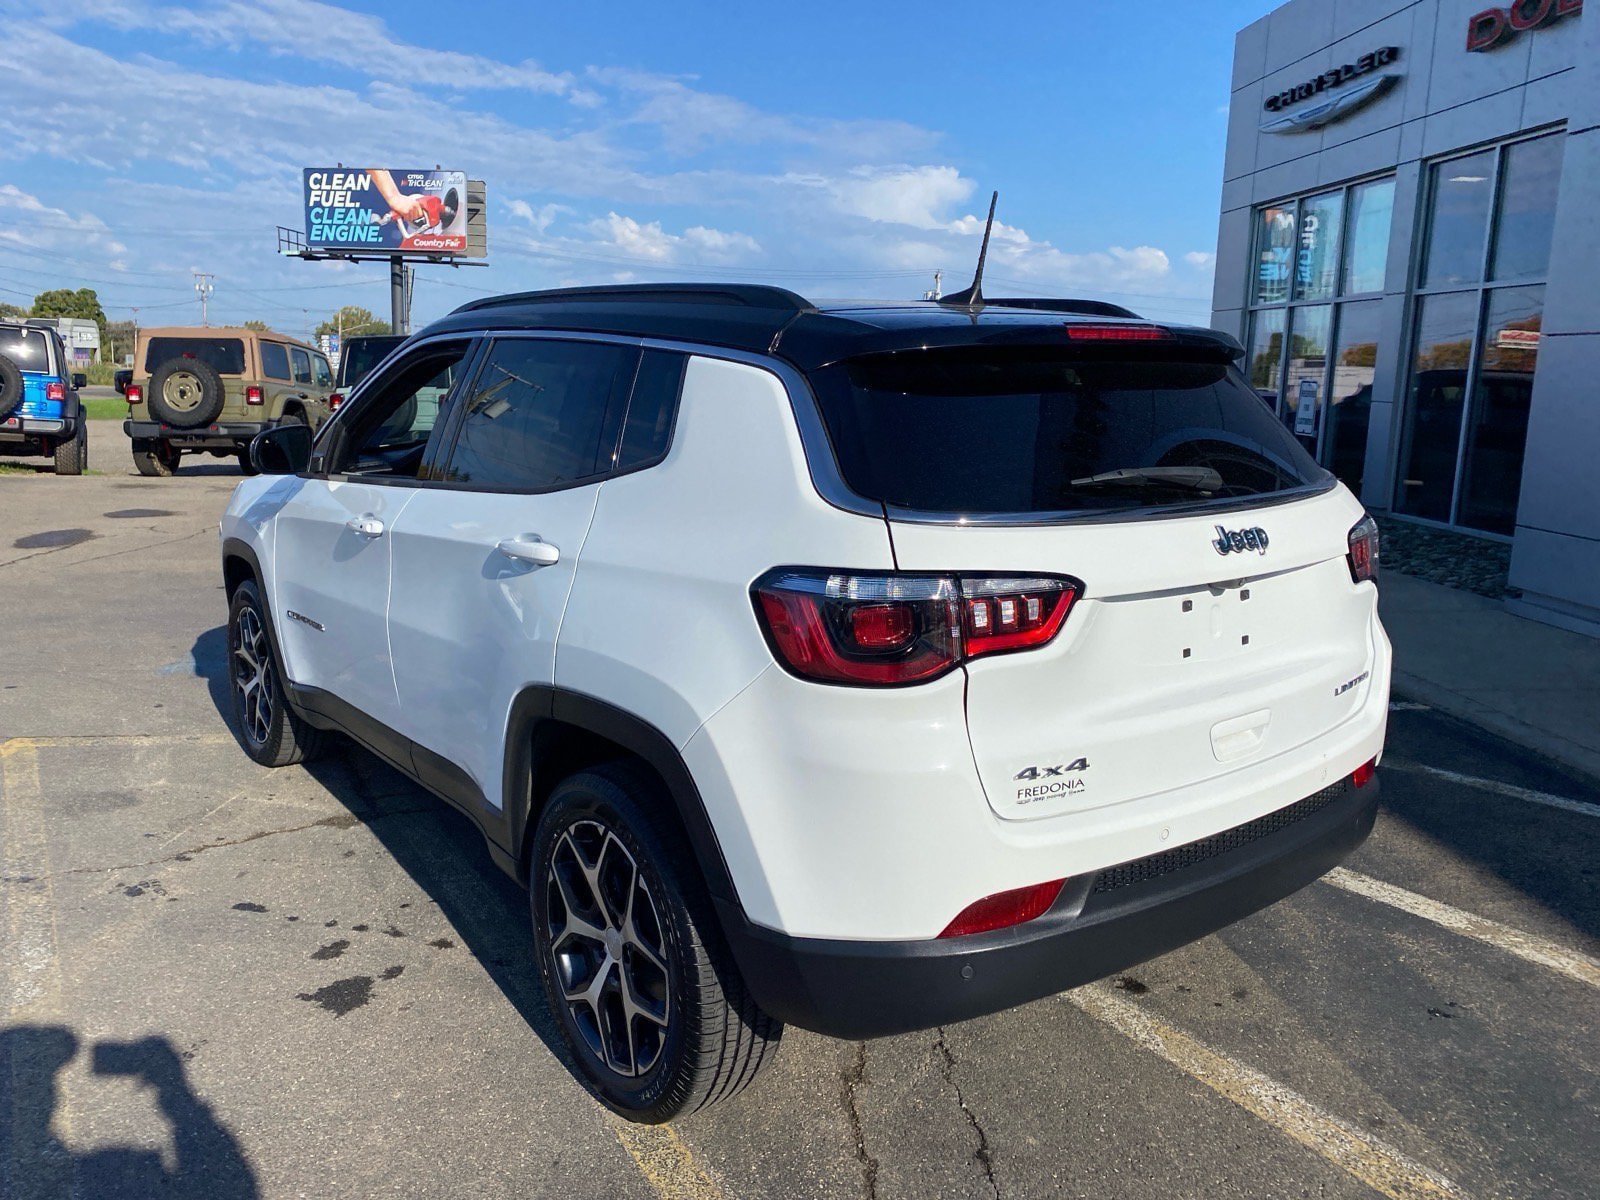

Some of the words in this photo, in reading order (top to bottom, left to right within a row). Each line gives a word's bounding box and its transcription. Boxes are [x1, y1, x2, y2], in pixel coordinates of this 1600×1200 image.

[1263, 46, 1402, 112] CHRYSLER
[309, 173, 371, 191] CLEAN
[309, 191, 360, 207] FUEL.
[310, 207, 372, 225] CLEAN
[310, 225, 383, 242] ENGINE.
[413, 239, 445, 248] Country
[445, 238, 460, 247] Fair
[1211, 525, 1270, 556] Jeep
[1012, 757, 1090, 781] 4x4
[1017, 779, 1085, 799] FREDONIA
